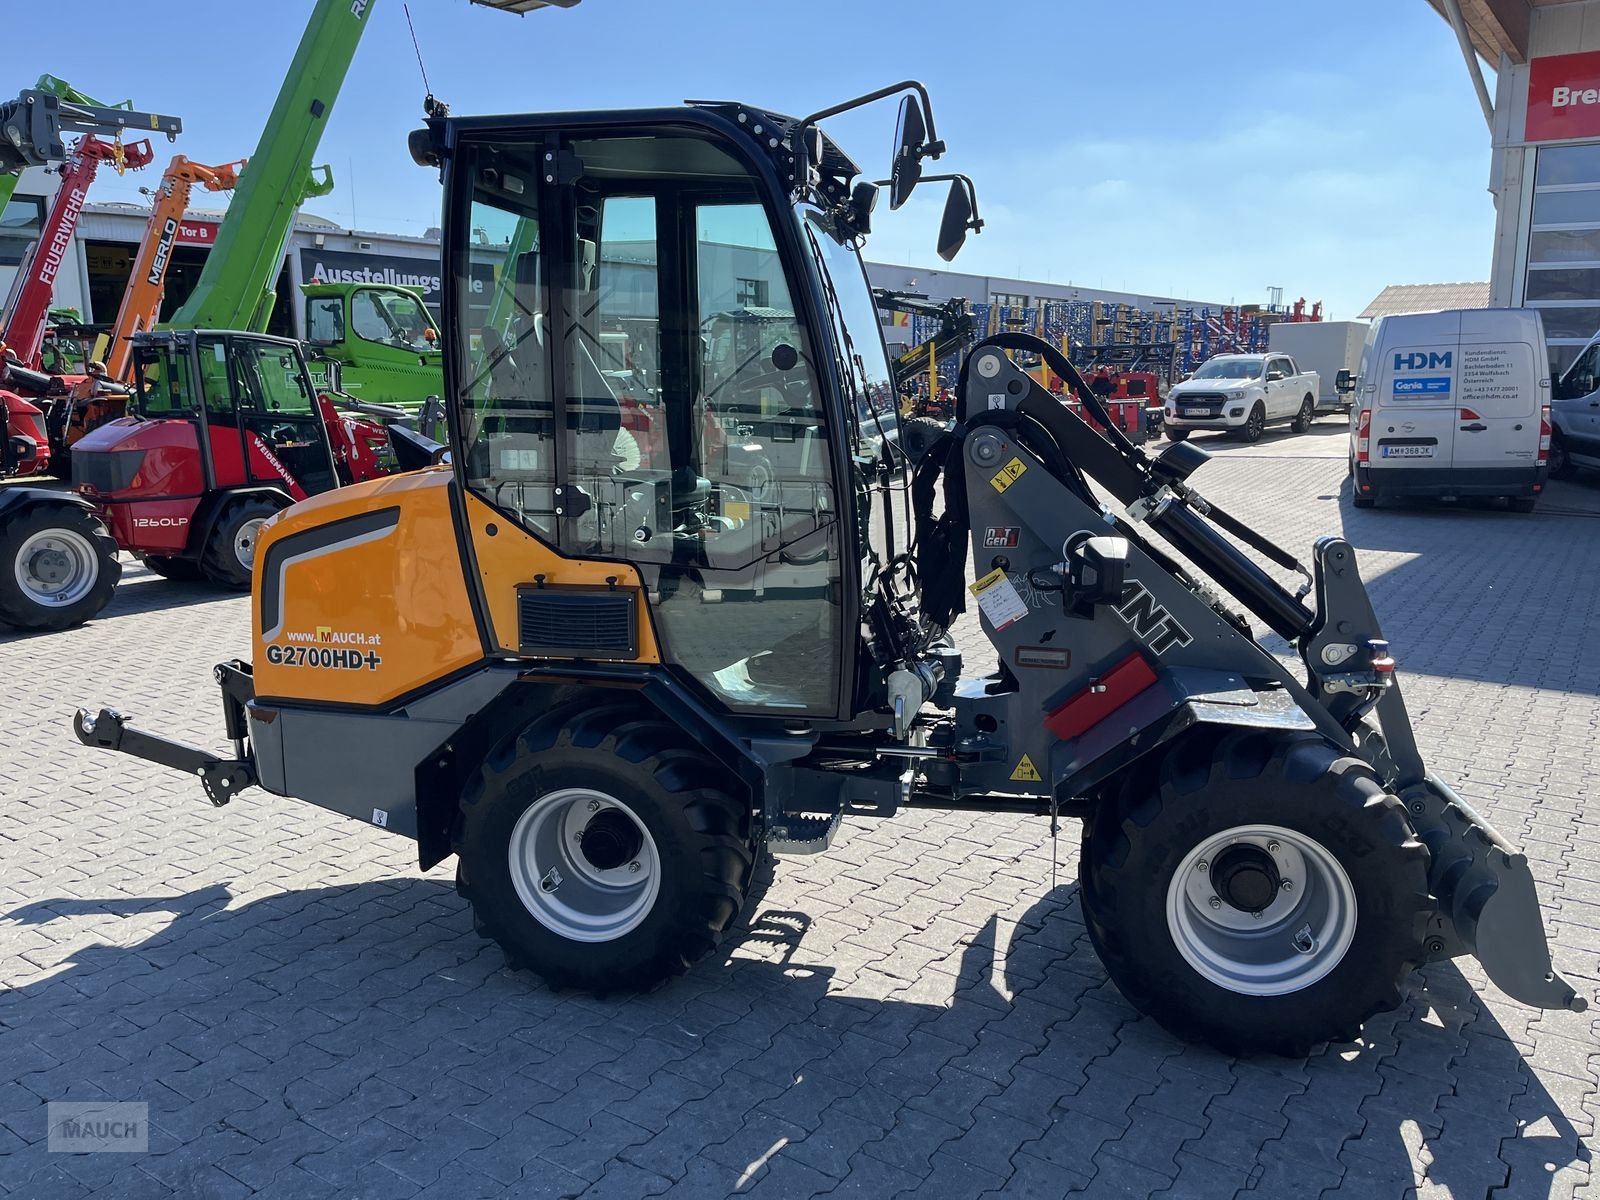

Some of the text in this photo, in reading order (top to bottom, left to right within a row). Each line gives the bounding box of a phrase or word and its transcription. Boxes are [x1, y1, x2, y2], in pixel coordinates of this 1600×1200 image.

[1551, 86, 1600, 108] Bre
[39, 188, 85, 285] FEUERWEHR
[180, 226, 208, 238] Tor B
[148, 219, 177, 285] MERLO
[1394, 351, 1452, 370] HDM
[254, 437, 295, 487] WEIDEMANN
[133, 518, 188, 527] 1260LP
[287, 631, 381, 645] www.MAUCH.at
[266, 644, 382, 671] G2700HD+
